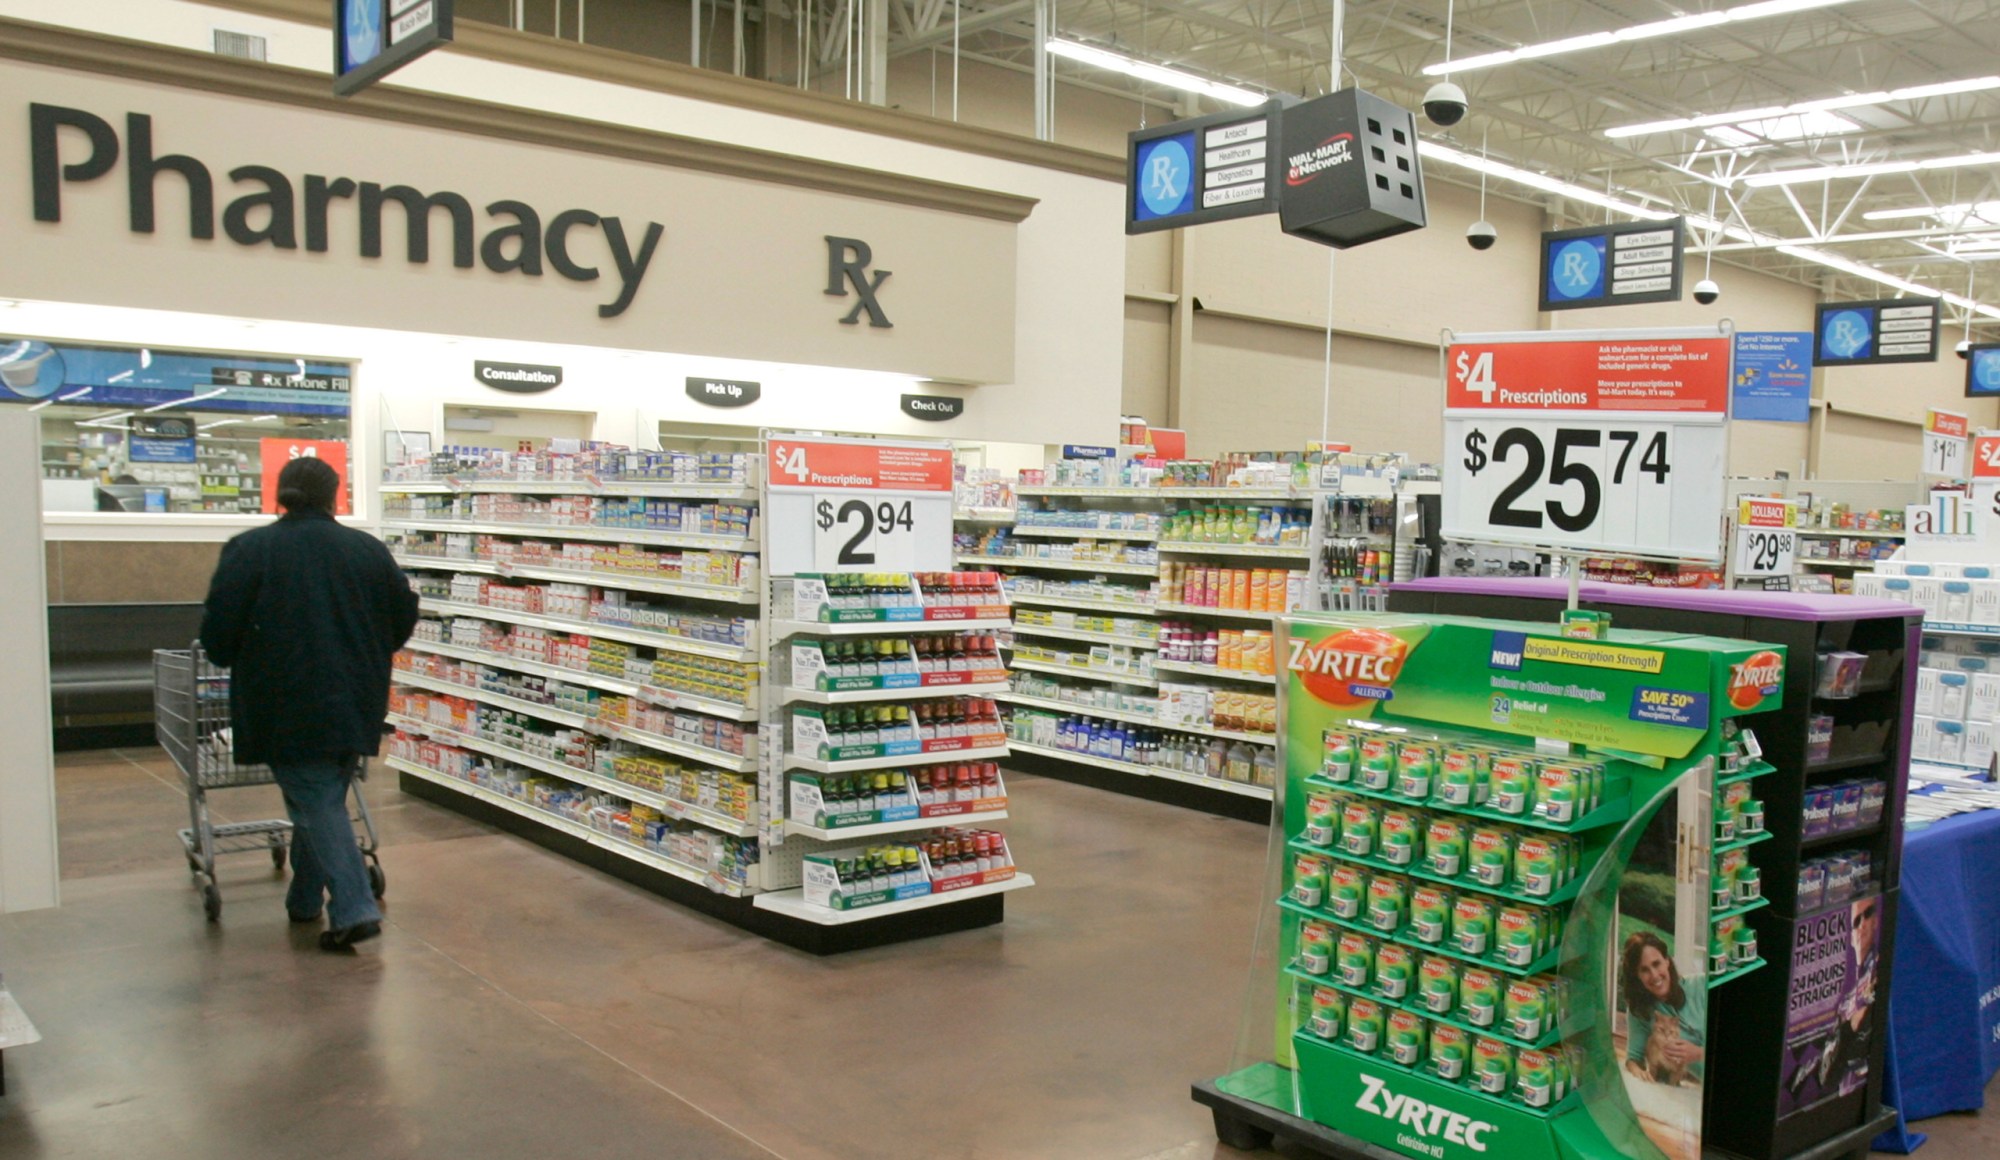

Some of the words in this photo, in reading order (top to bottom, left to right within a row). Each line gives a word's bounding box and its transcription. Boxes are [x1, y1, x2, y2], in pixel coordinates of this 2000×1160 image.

[1224, 127, 1248, 139] Antacid
[1218, 148, 1251, 161] Healthcare
[1298, 150, 1353, 176] Network
[1152, 155, 1180, 200] Rx
[1217, 168, 1253, 182] Diagnostics
[1204, 193, 1222, 203] Fiber
[1224, 190, 1230, 199] &
[29, 101, 664, 318] Pharmacy
[1562, 252, 1589, 287] Rx
[823, 235, 893, 328] Rx
[1737, 343, 1749, 351] Get
[1749, 343, 1758, 351] No
[1738, 335, 1758, 344] Spend
[1598, 353, 1640, 362] walmart.com
[1640, 353, 1650, 361] for
[1655, 353, 1688, 362] complete
[1688, 352, 1699, 360] list
[1700, 352, 1709, 360] of
[1599, 345, 1612, 353] Ask
[1611, 345, 1622, 353] the
[1622, 344, 1659, 354] pharmacist
[1667, 344, 1683, 352] visit
[1598, 361, 1626, 370] included
[1626, 361, 1650, 371] generic
[1650, 362, 1672, 371] drugs.
[482, 367, 556, 384] Consultation
[1456, 350, 1497, 403] $4
[331, 377, 350, 391] Fill
[705, 383, 726, 395] Pick
[727, 384, 743, 398] Up
[1597, 387, 1627, 396] Wal-Mart
[1627, 388, 1647, 397] today.
[1647, 388, 1658, 396] It's
[1658, 389, 1676, 397] easy.
[1598, 379, 1615, 387] Move
[1615, 380, 1631, 389] your
[1631, 379, 1674, 389] prescriptions
[1674, 379, 1683, 387] to
[1499, 387, 1588, 407] Prescriptions
[911, 399, 937, 412] Check
[937, 401, 954, 413] Out
[775, 445, 809, 483] $4
[811, 471, 873, 487] Prescriptions
[1751, 505, 1784, 519] ROLLBACK
[1914, 495, 1976, 536] alli
[1287, 638, 1394, 682] ZYRTEC
[1491, 650, 1521, 667] NEW!
[1525, 639, 1559, 657] Original
[1560, 642, 1616, 664] Prescription
[1616, 653, 1658, 668] Strength
[1733, 664, 1783, 688] ZYRTEC
[1353, 686, 1388, 699] ALLERGY
[1490, 675, 1519, 690] Indoor
[1526, 680, 1564, 696] Outdoor
[1563, 683, 1606, 702] Allergies
[1640, 689, 1670, 705] SAVE
[1493, 698, 1510, 714] 24
[1512, 700, 1537, 713] Relief
[1538, 703, 1548, 714] of
[1796, 911, 1847, 948] BLOCK
[1794, 947, 1816, 967] THE
[1818, 938, 1847, 960] BURN
[1792, 978, 1806, 994] 24
[1806, 961, 1846, 986] HOURS
[1790, 979, 1844, 1011] STRAIGHT
[1396, 1132, 1431, 1155] Cetirizine
